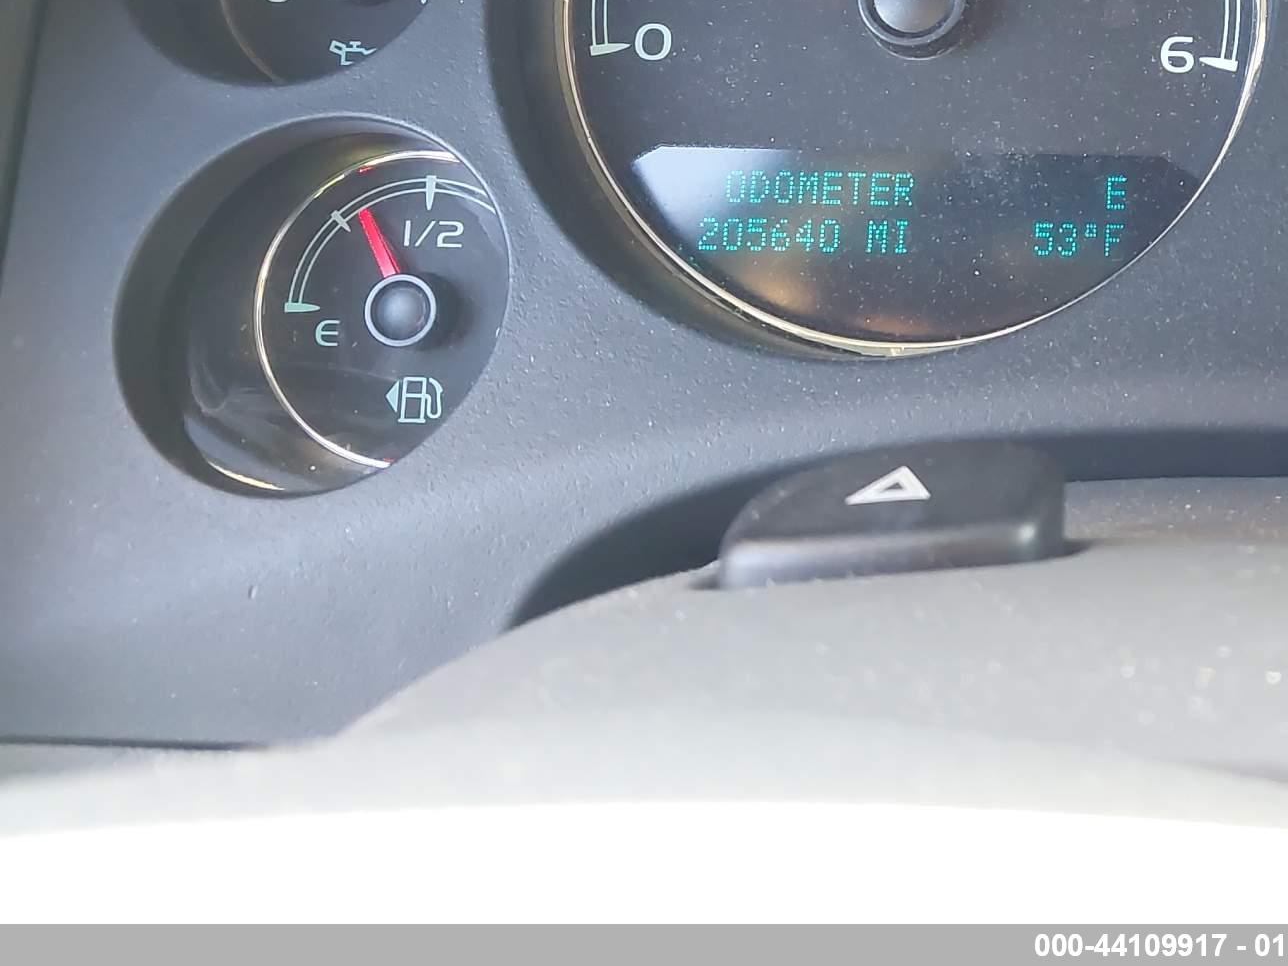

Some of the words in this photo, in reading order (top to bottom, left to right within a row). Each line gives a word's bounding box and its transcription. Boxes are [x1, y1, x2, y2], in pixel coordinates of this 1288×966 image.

[634, 23, 672, 61] 0
[1160, 36, 1195, 74] 6
[725, 169, 915, 208] ODOMETER
[1104, 174, 1130, 211] E
[403, 219, 465, 248] 1/2
[696, 215, 842, 255] 205640
[863, 218, 910, 256] MI
[1030, 220, 1126, 259] 53°F
